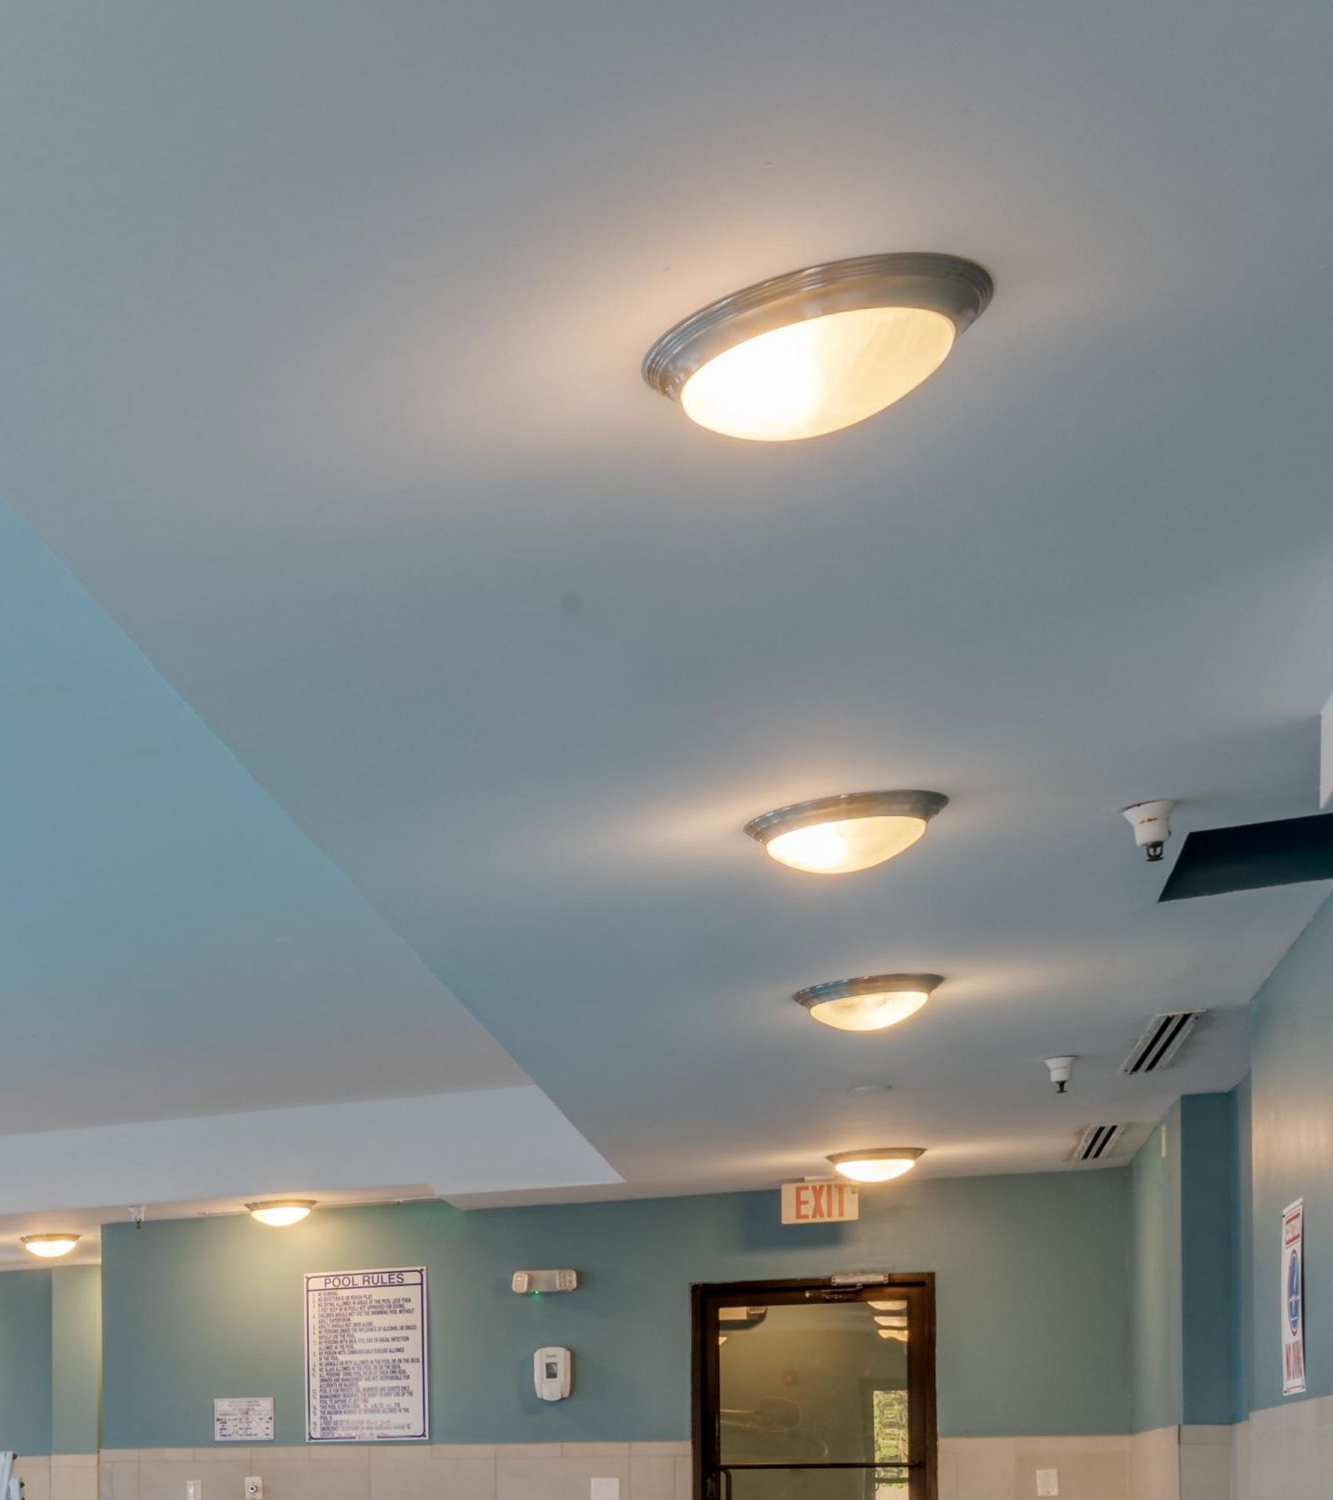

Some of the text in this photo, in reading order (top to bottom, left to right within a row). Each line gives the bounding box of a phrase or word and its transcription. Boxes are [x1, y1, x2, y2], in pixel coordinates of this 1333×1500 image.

[795, 1184, 846, 1220] EXIT
[324, 1273, 405, 1287] POOL RULES
